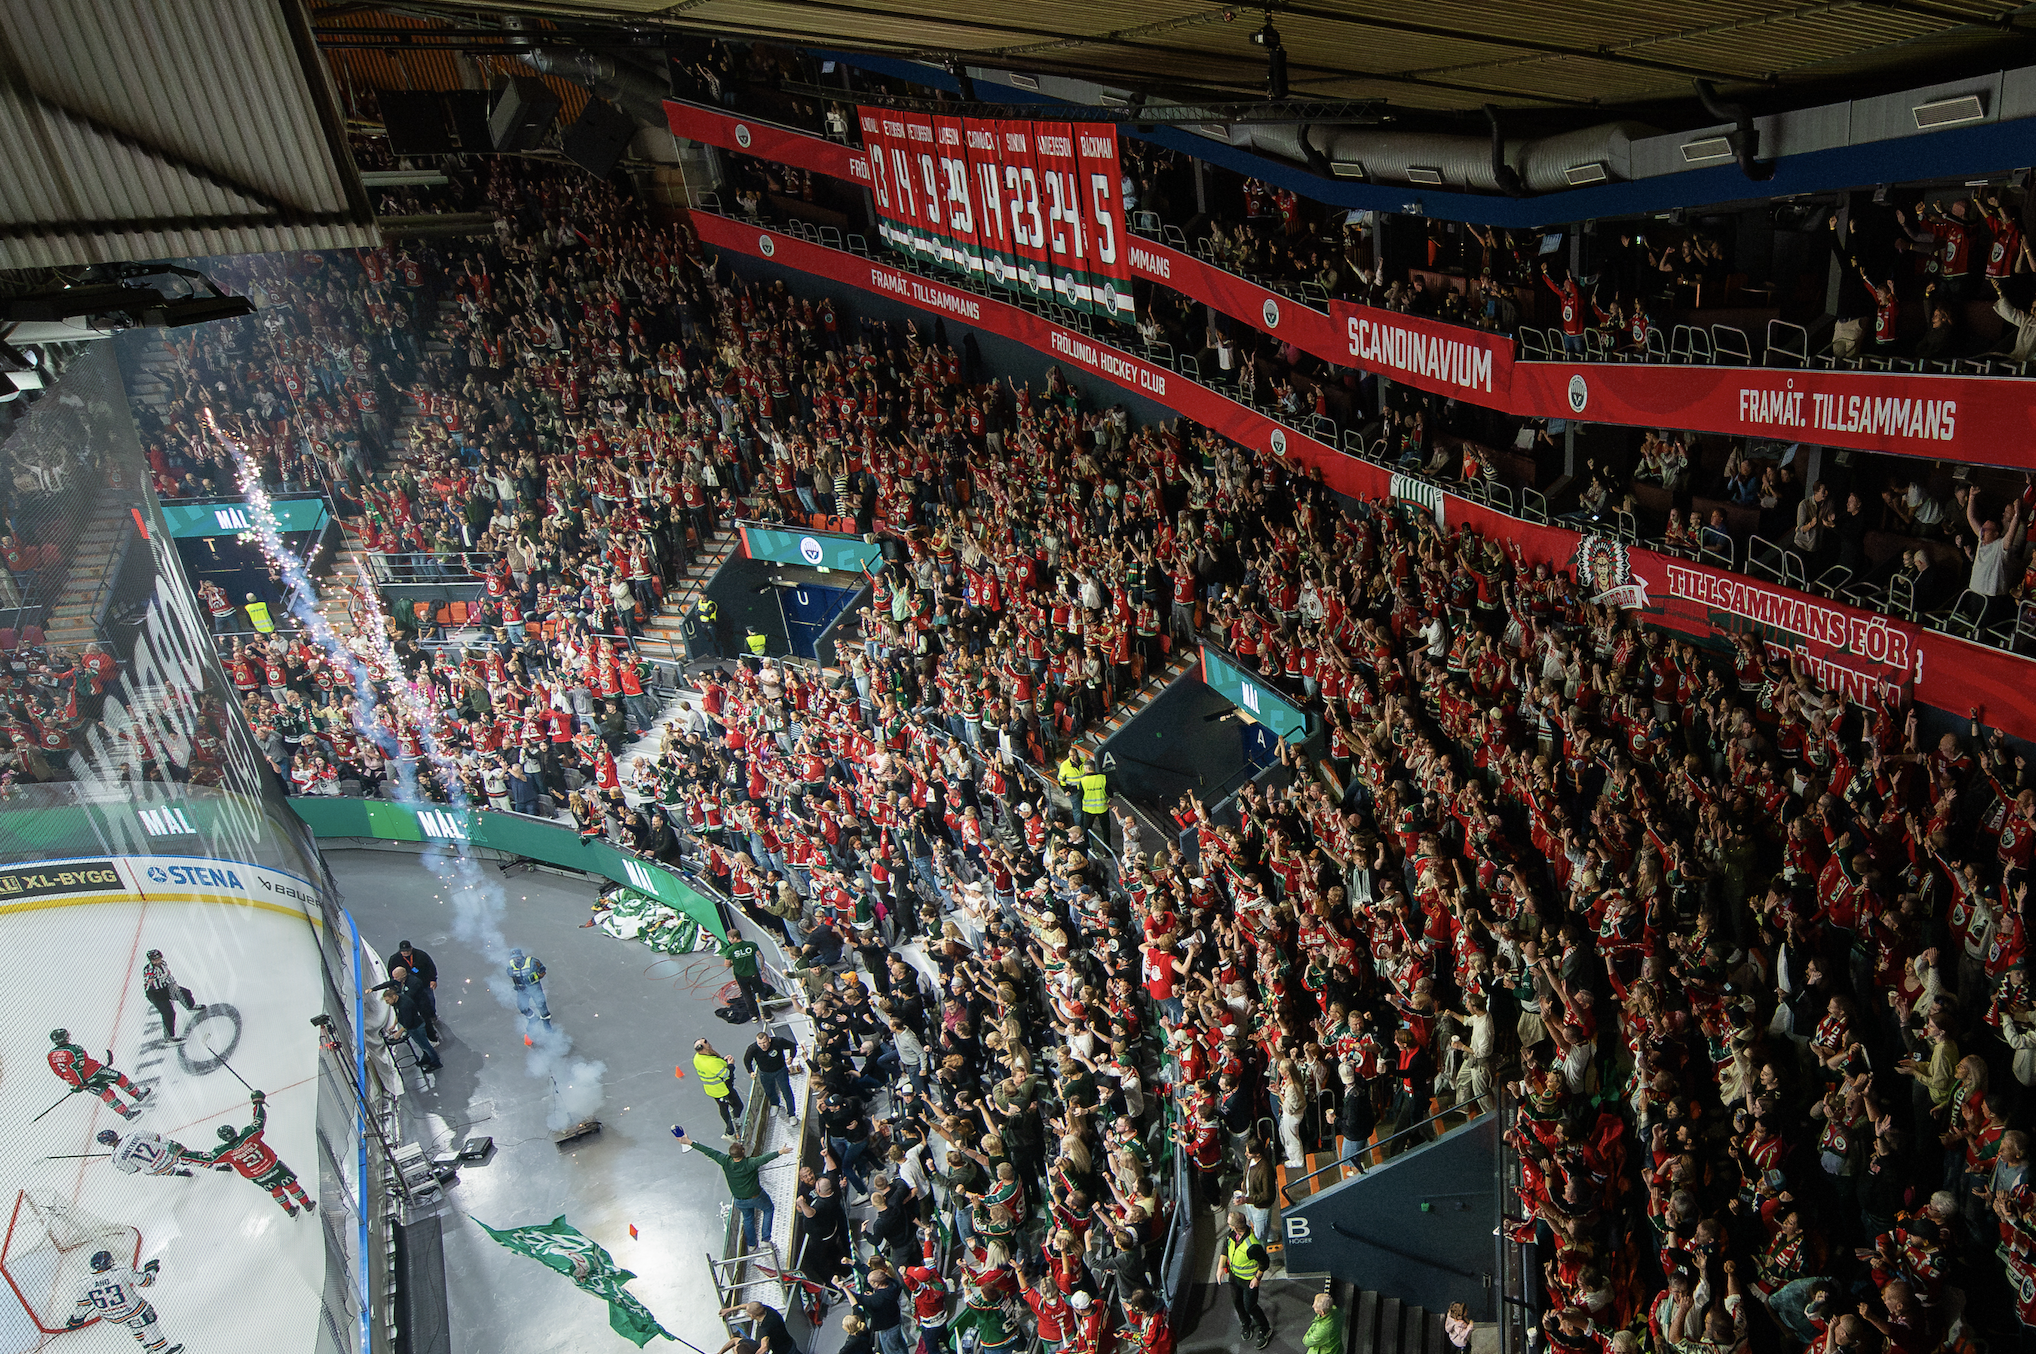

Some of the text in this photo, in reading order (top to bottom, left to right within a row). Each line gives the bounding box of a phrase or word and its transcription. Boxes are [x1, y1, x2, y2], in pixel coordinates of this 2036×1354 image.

[1080, 131, 1113, 159] BÄCKMAN
[868, 143, 890, 209] 13
[891, 148, 916, 217] 14
[941, 157, 973, 234] 29
[977, 163, 1003, 241] 14
[1005, 165, 1044, 249] 23
[1045, 170, 1083, 259] 24
[1091, 173, 1116, 265] 5
[871, 268, 980, 321] FRAMÅT. TILLSAMMANS
[1051, 331, 1166, 396] FRÖLUNDA HOCKEY CLUB
[1347, 316, 1492, 393] SCANDINAVIUM
[1739, 378, 1957, 441] FRAMÅT. TILLSAMMANS
[213, 507, 252, 529] MÅL
[203, 538, 216, 552] T
[796, 590, 809, 606] U
[685, 620, 696, 635] U
[1667, 564, 1848, 649] TILLSAMMANS
[1850, 616, 1909, 670] FÖR
[1257, 729, 1266, 749] A
[1102, 751, 1117, 769] A
[139, 805, 197, 846] MÅL
[416, 808, 467, 840] MÅL
[21, 869, 118, 890] XL-BYGG
[168, 866, 245, 890] STENA
[734, 946, 753, 958] SLO
[1286, 1217, 1311, 1239] B
[88, 1284, 126, 1309] 63
